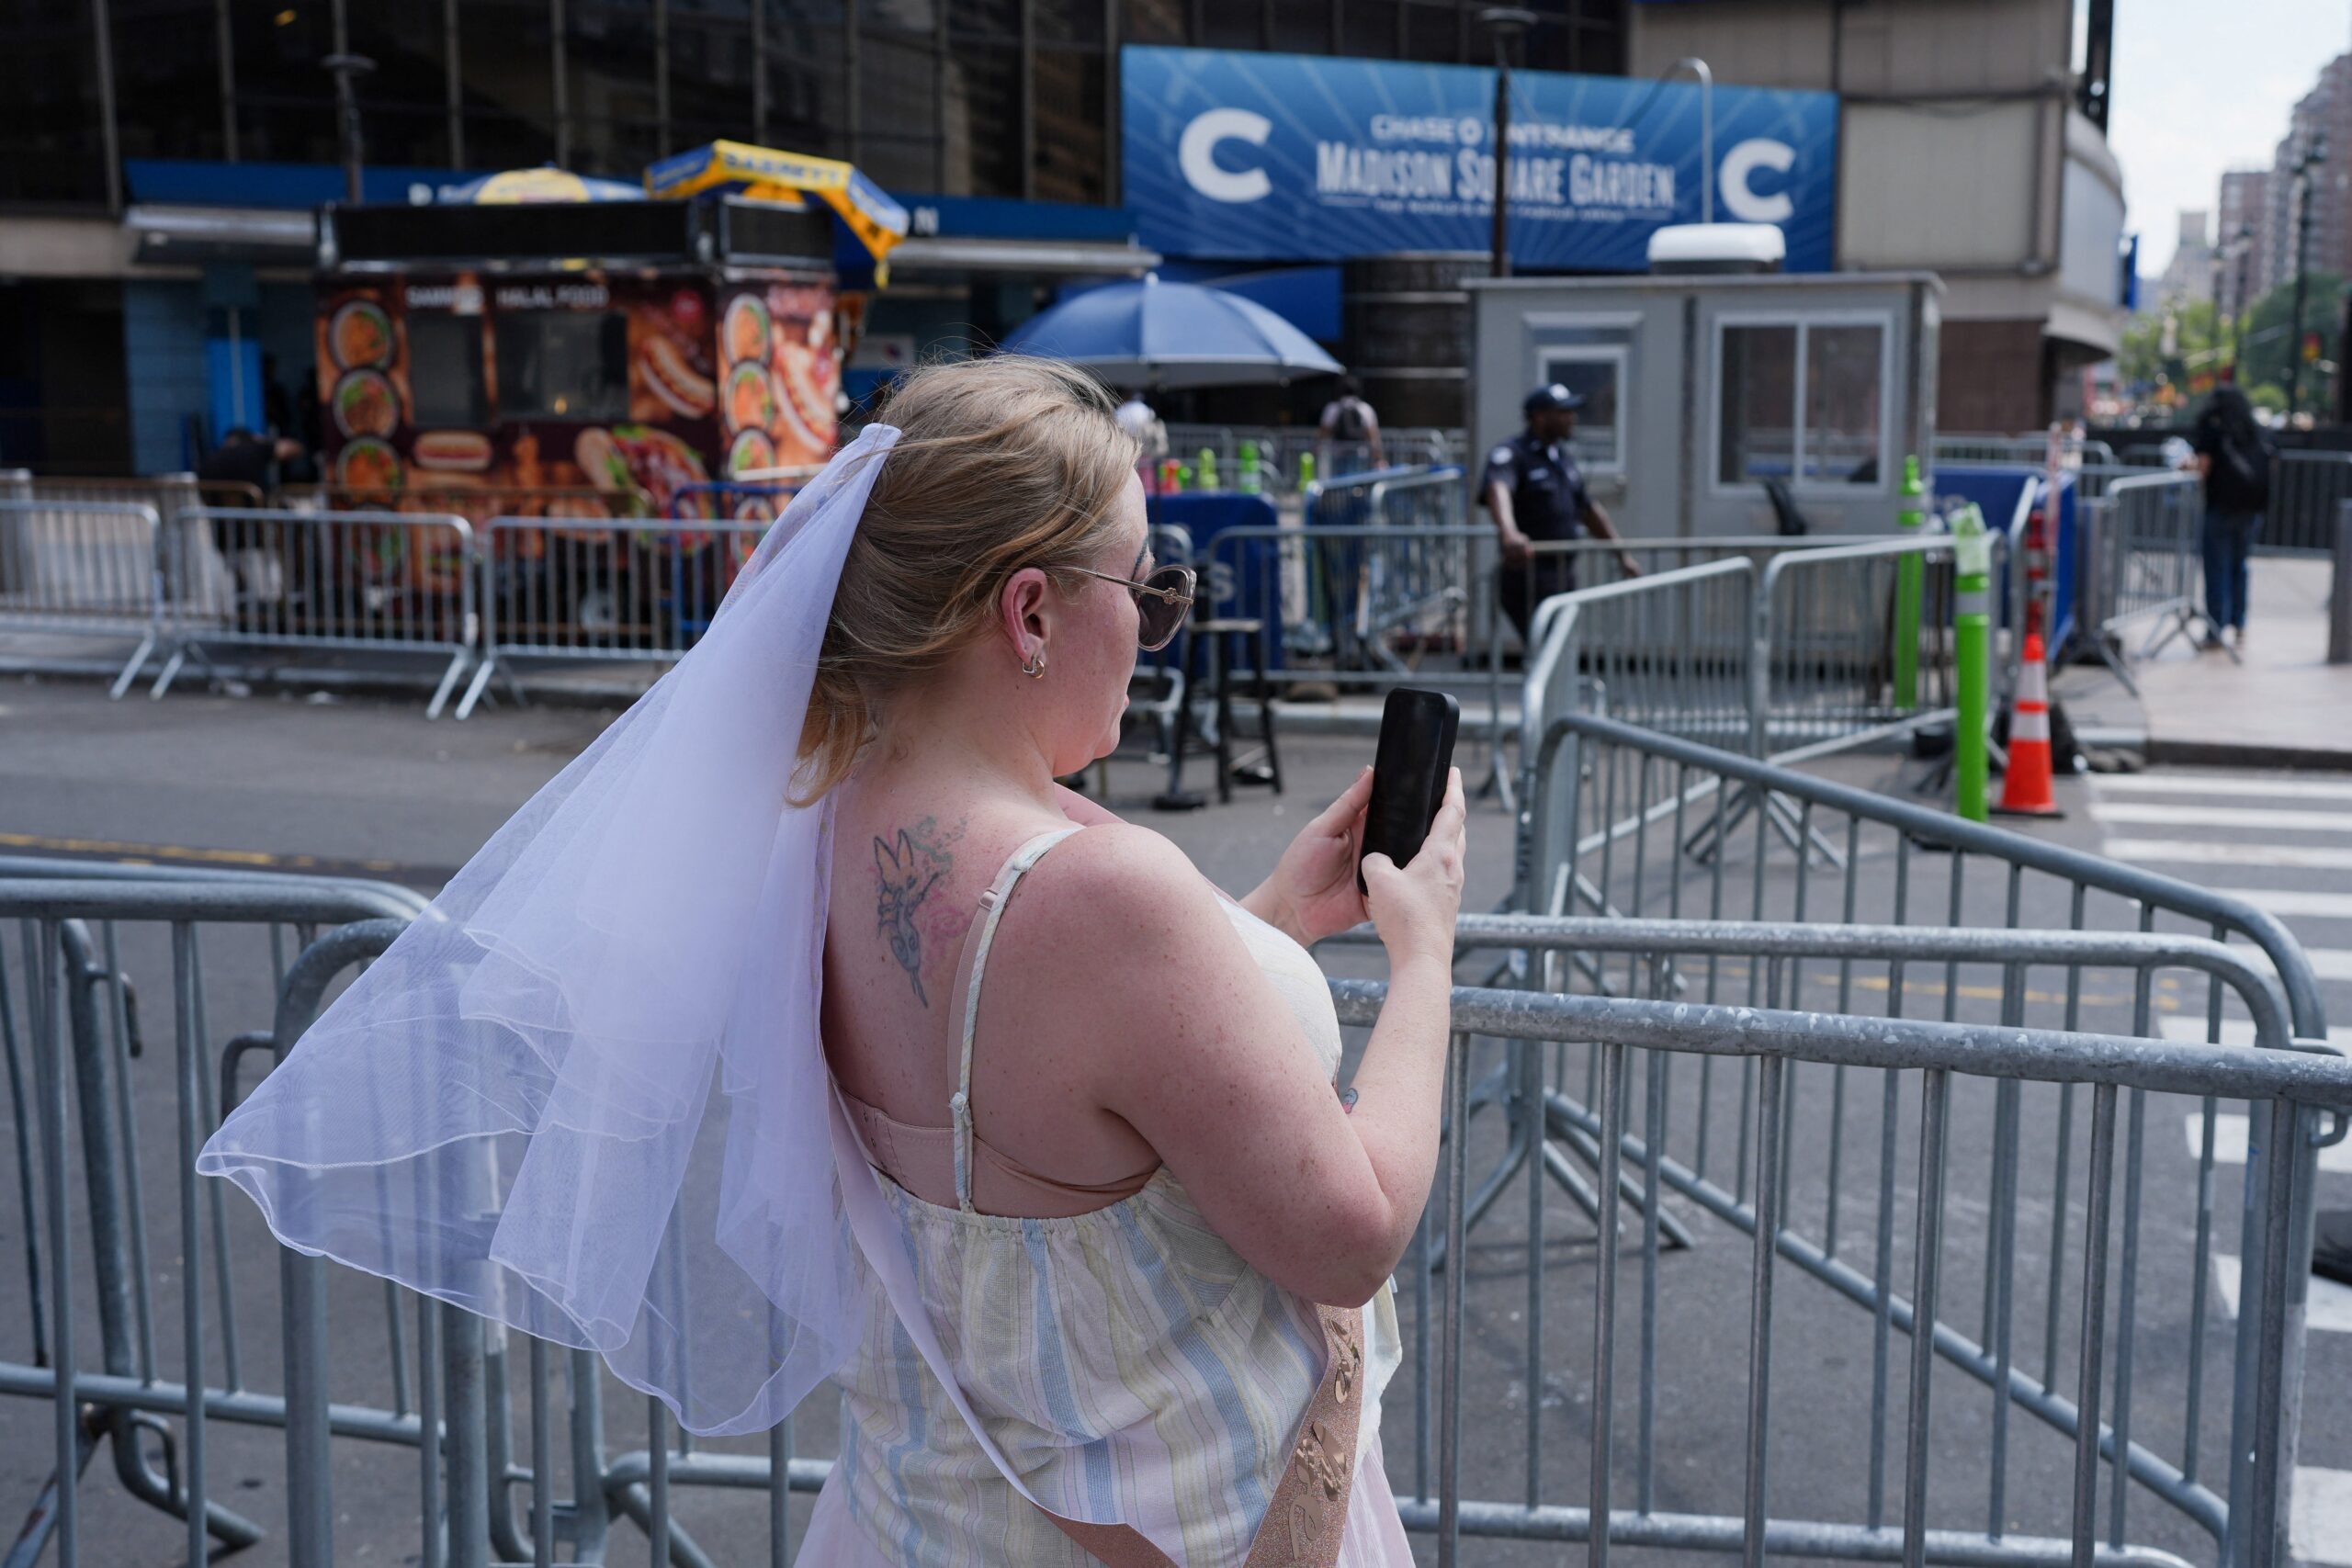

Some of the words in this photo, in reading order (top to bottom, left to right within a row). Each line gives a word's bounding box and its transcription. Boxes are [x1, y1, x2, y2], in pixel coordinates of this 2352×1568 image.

[1179, 107, 1272, 203] C
[1371, 114, 1455, 144] CHASE
[1317, 141, 1452, 197] MADISON
[1569, 152, 1676, 209] GARDEN
[1719, 138, 1795, 221] C
